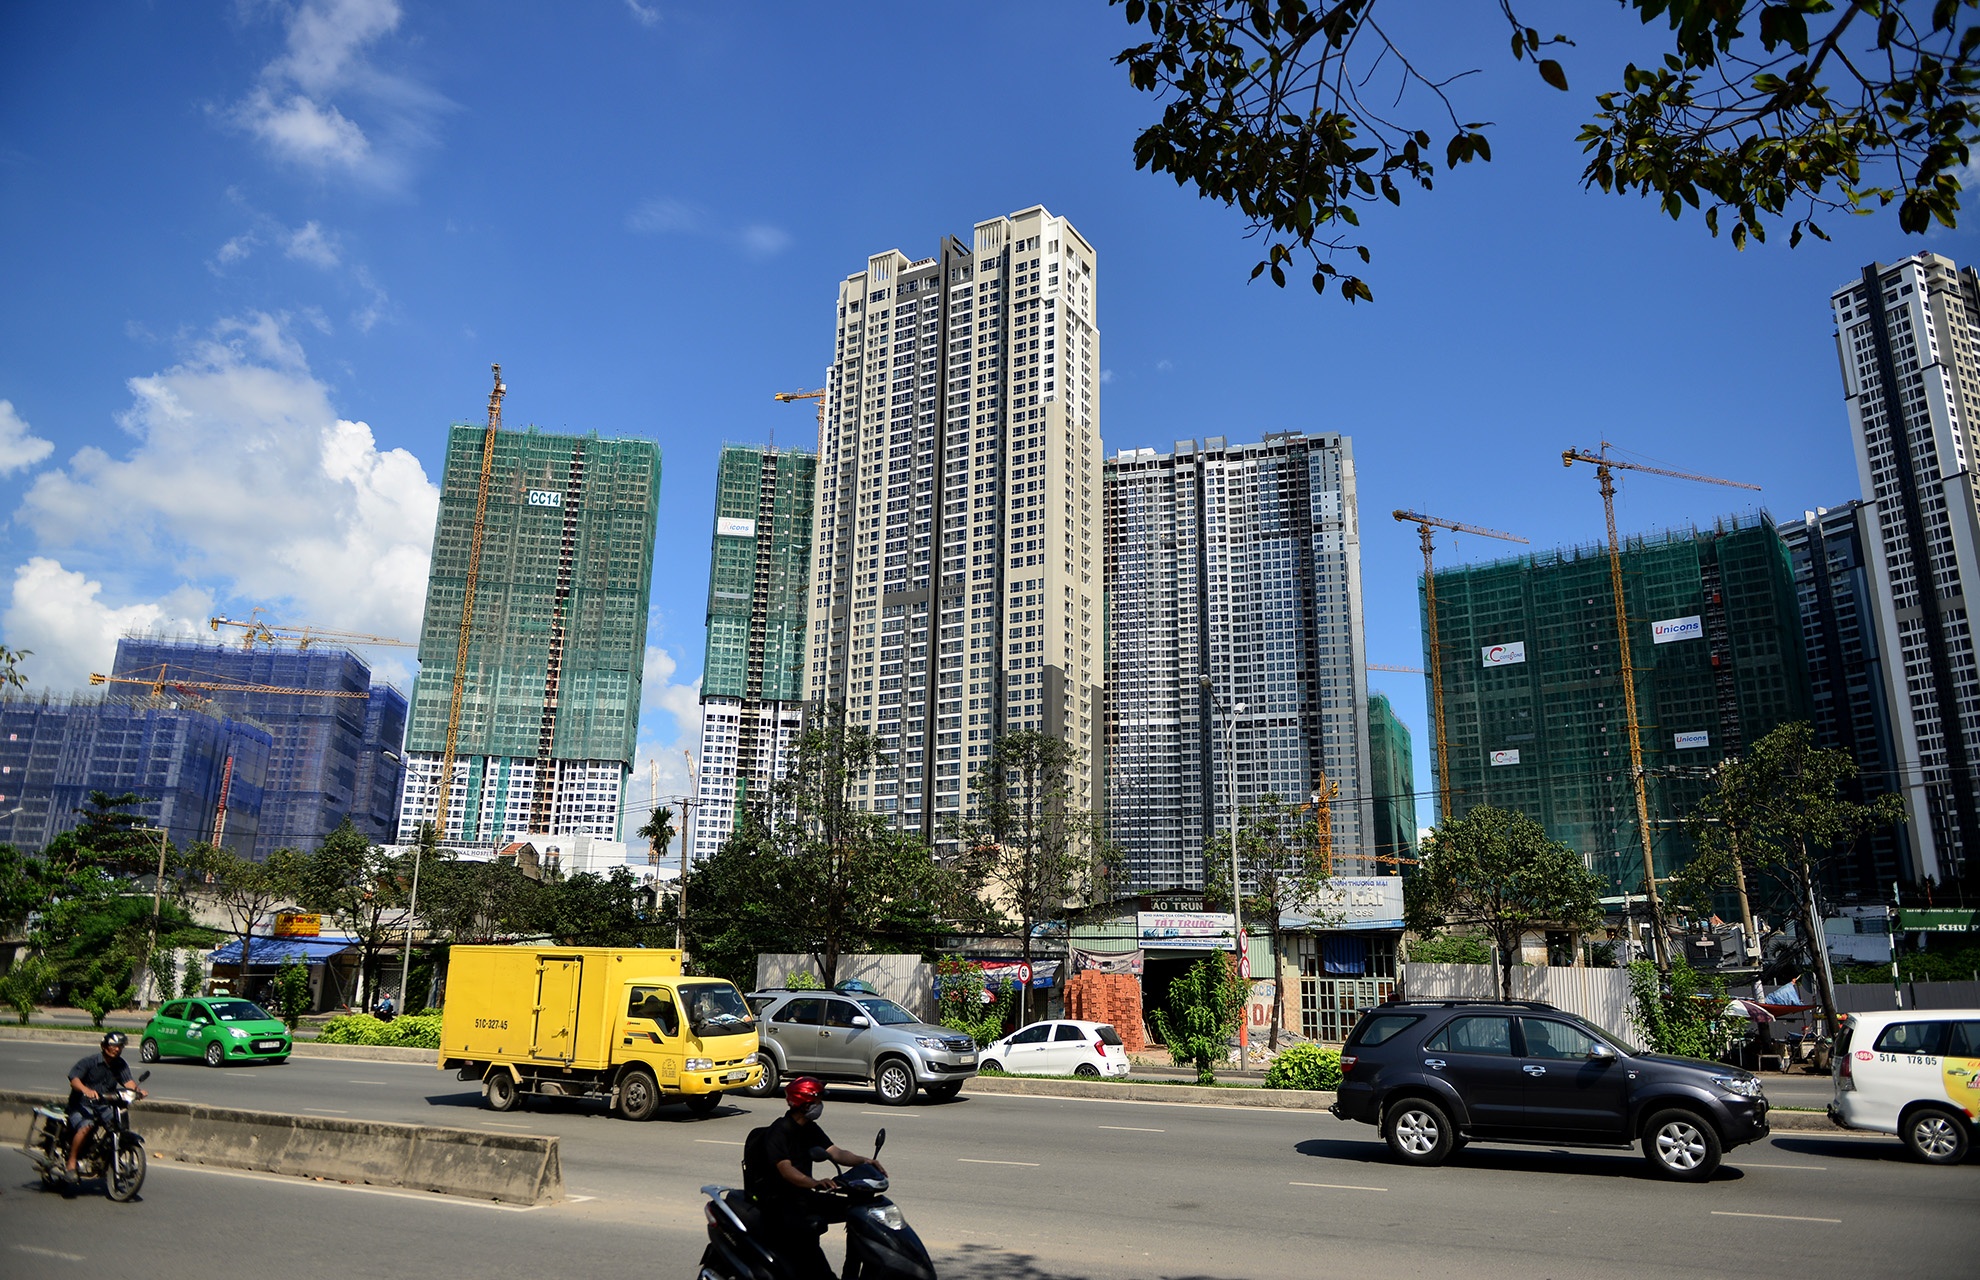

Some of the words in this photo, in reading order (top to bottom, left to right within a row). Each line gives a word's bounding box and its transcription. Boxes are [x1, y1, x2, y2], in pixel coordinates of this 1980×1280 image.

[531, 492, 559, 505] CC14
[1655, 622, 1699, 634] Unicons
[1177, 919, 1215, 928] TRUNG
[1937, 924, 1967, 932] KHU
[1879, 1053, 1898, 1063] 51A
[1906, 1055, 1923, 1065] 178
[1924, 1056, 1937, 1066] 05
